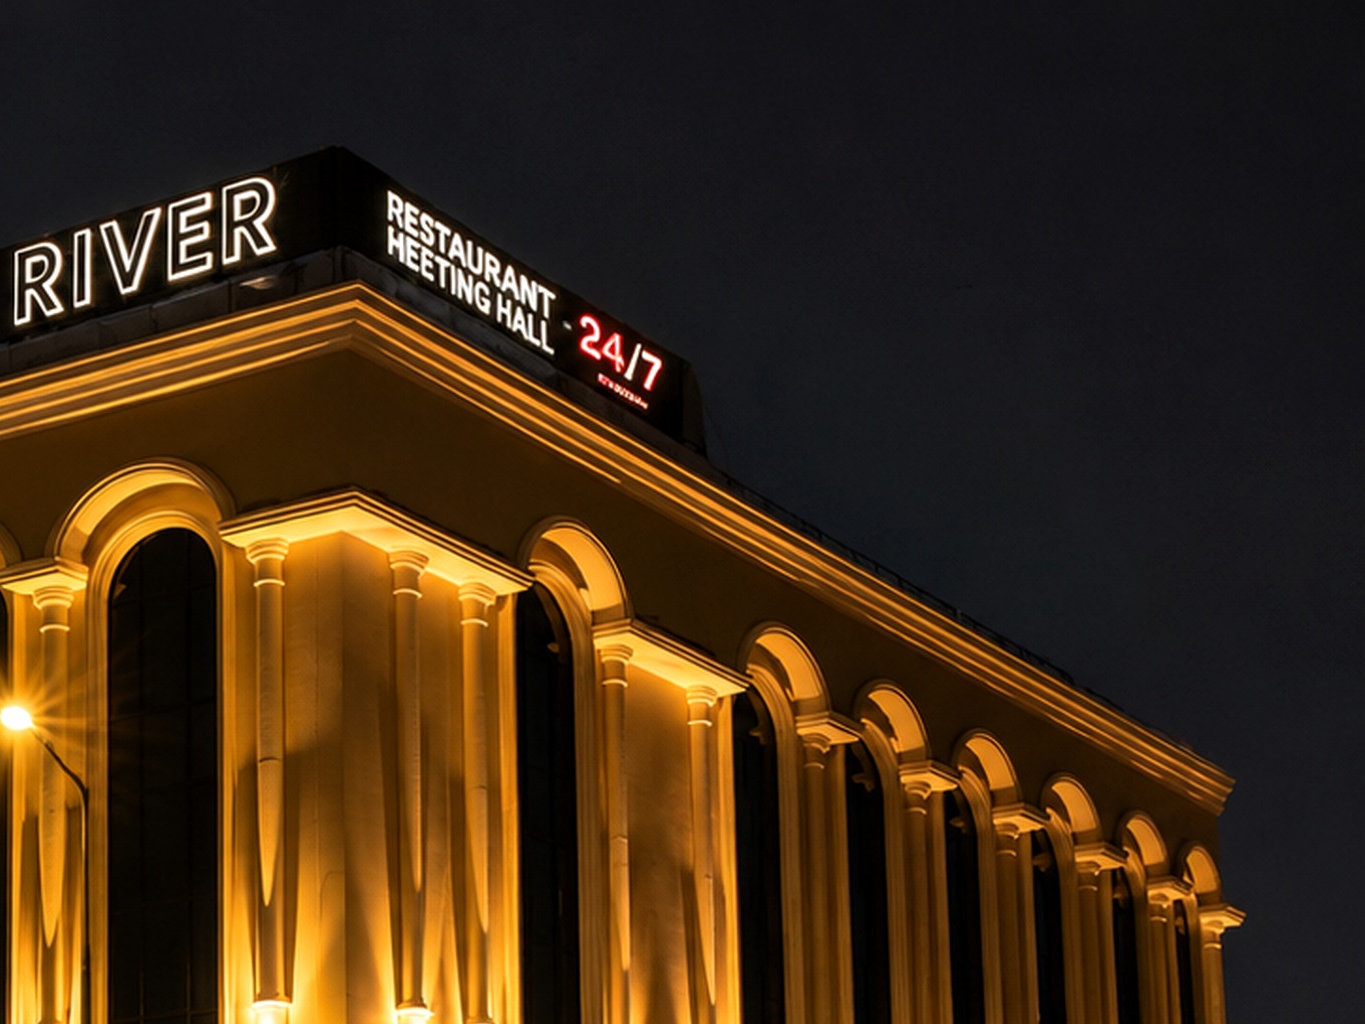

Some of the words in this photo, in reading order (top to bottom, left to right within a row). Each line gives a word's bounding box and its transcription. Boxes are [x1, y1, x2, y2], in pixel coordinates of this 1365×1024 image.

[13, 177, 277, 326] RIVER
[387, 190, 556, 318] RESTAURANT
[496, 293, 555, 355] HALL
[579, 314, 663, 391] 24/7
